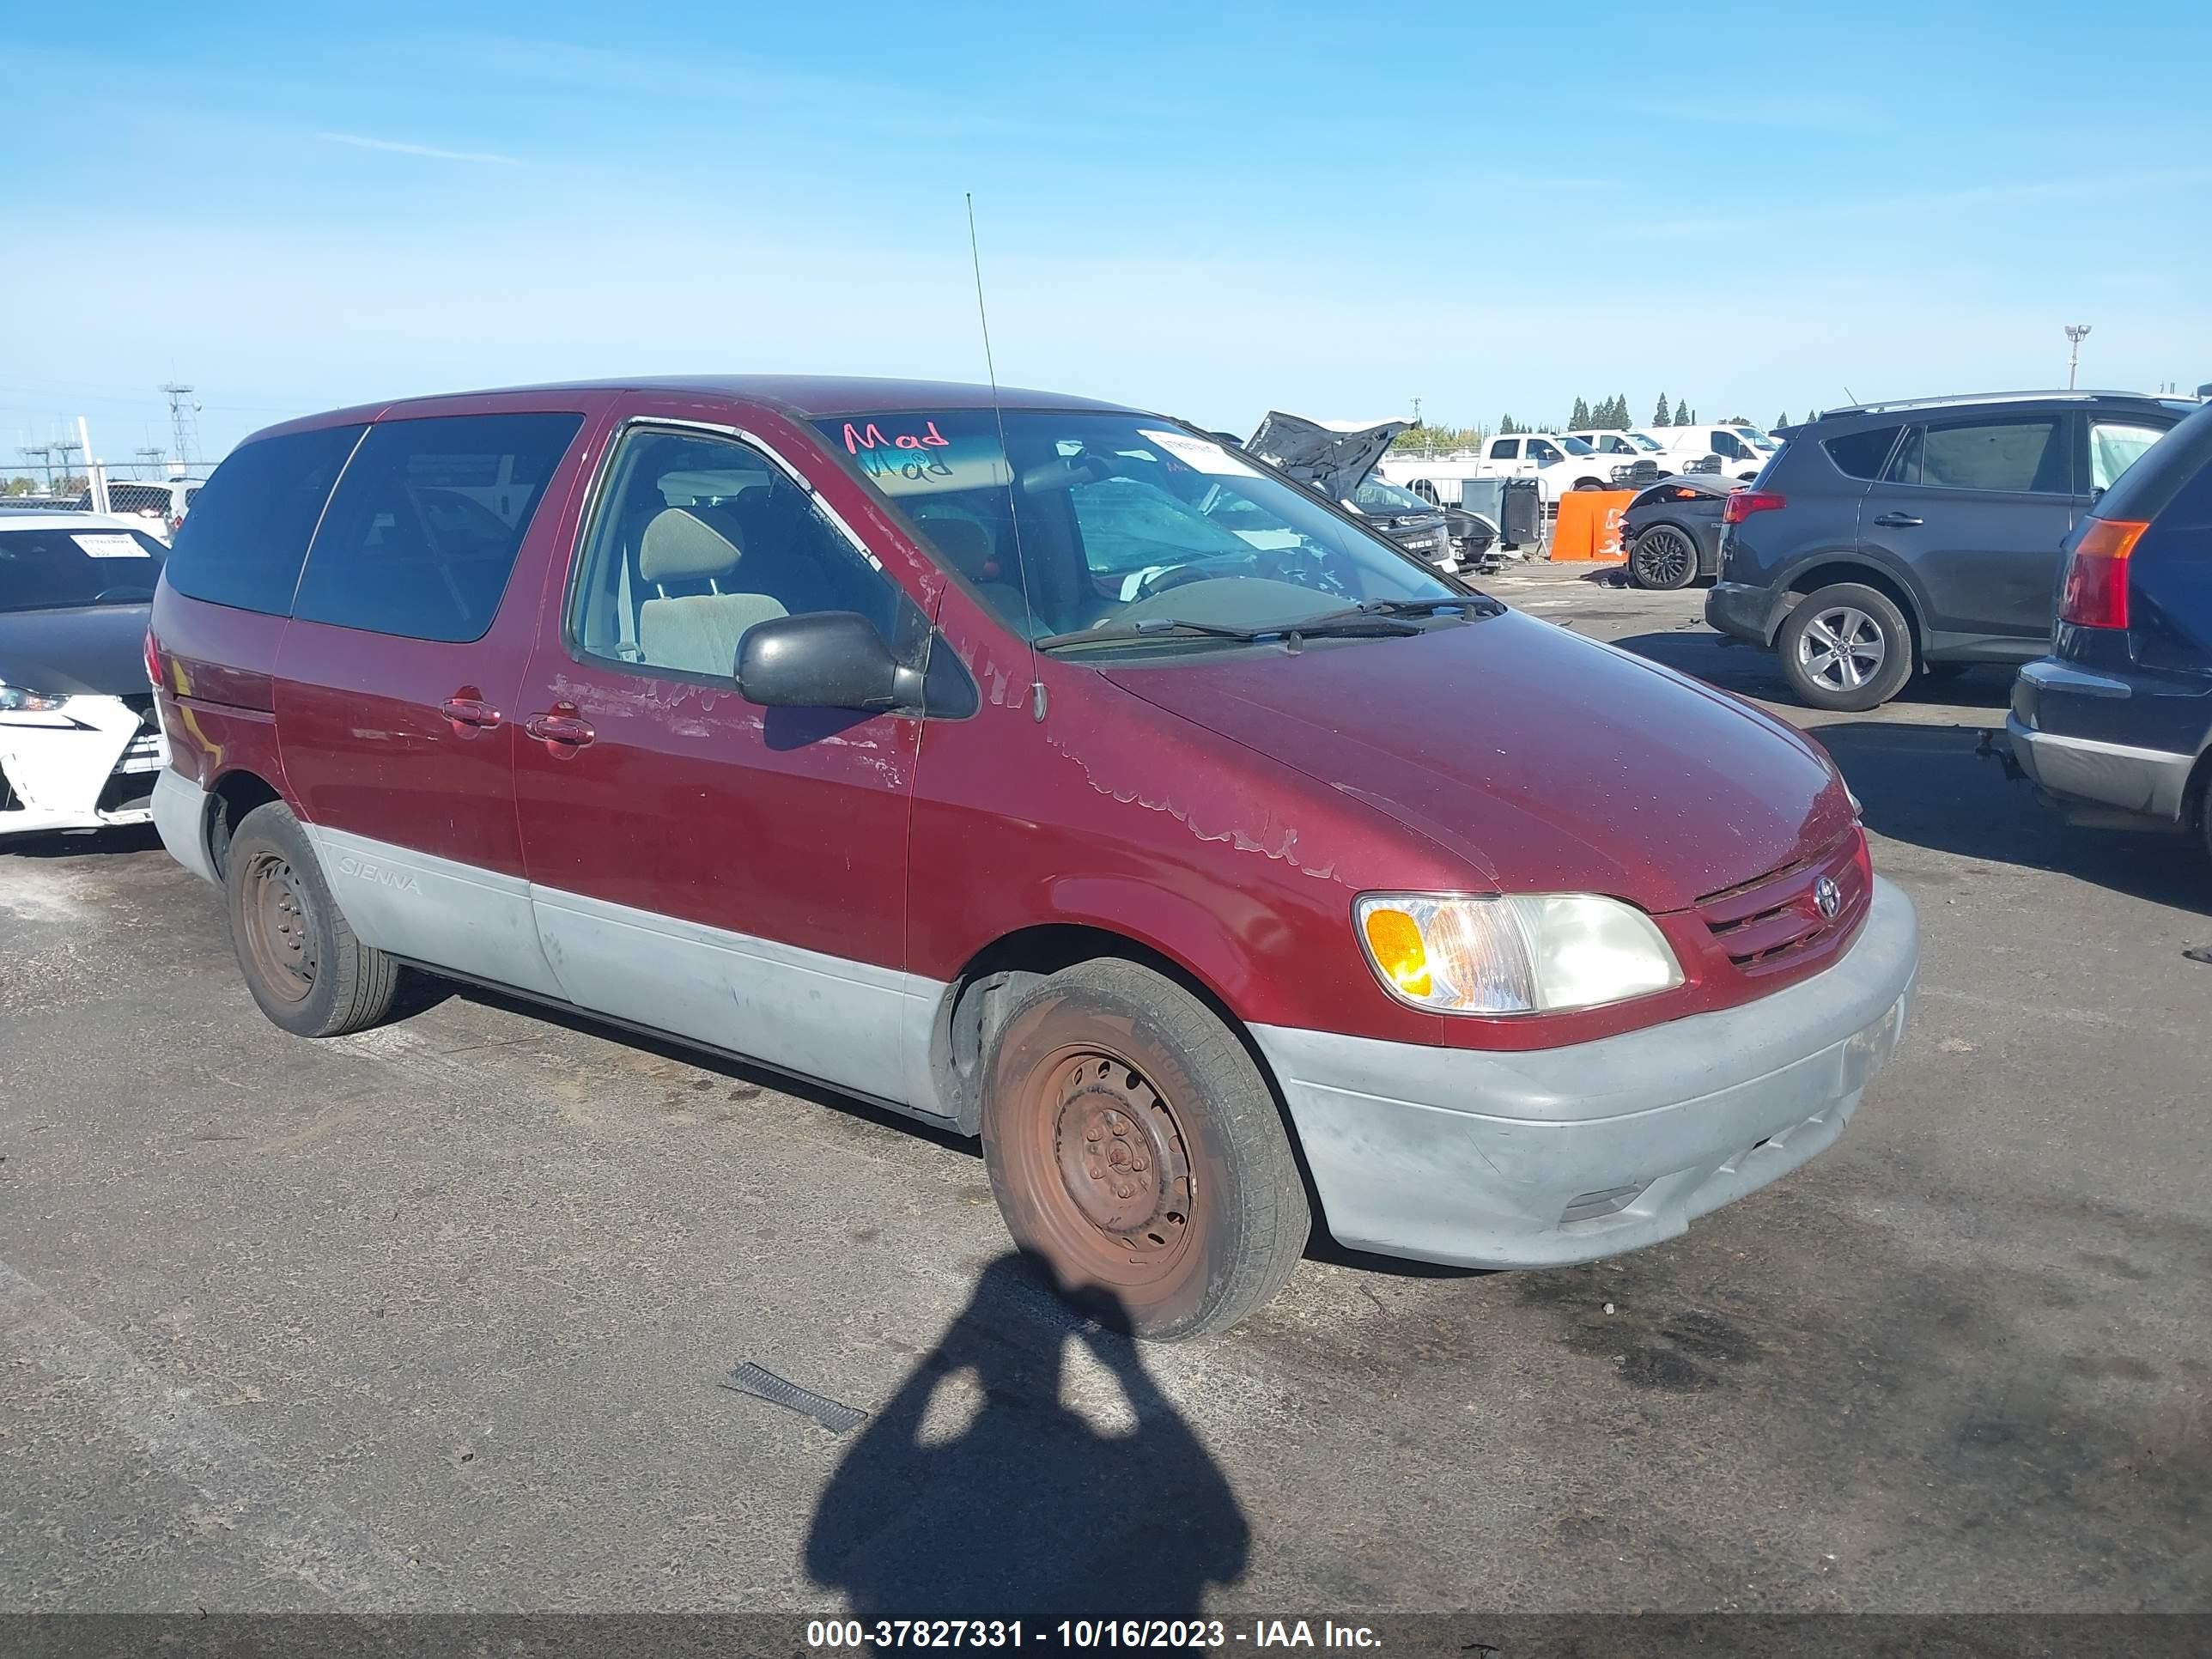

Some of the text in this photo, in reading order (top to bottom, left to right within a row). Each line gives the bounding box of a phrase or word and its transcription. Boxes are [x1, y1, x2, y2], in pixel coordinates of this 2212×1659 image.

[843, 421, 950, 454] Mad
[1403, 539, 1433, 550] NCO
[338, 856, 423, 895] SIENNA
